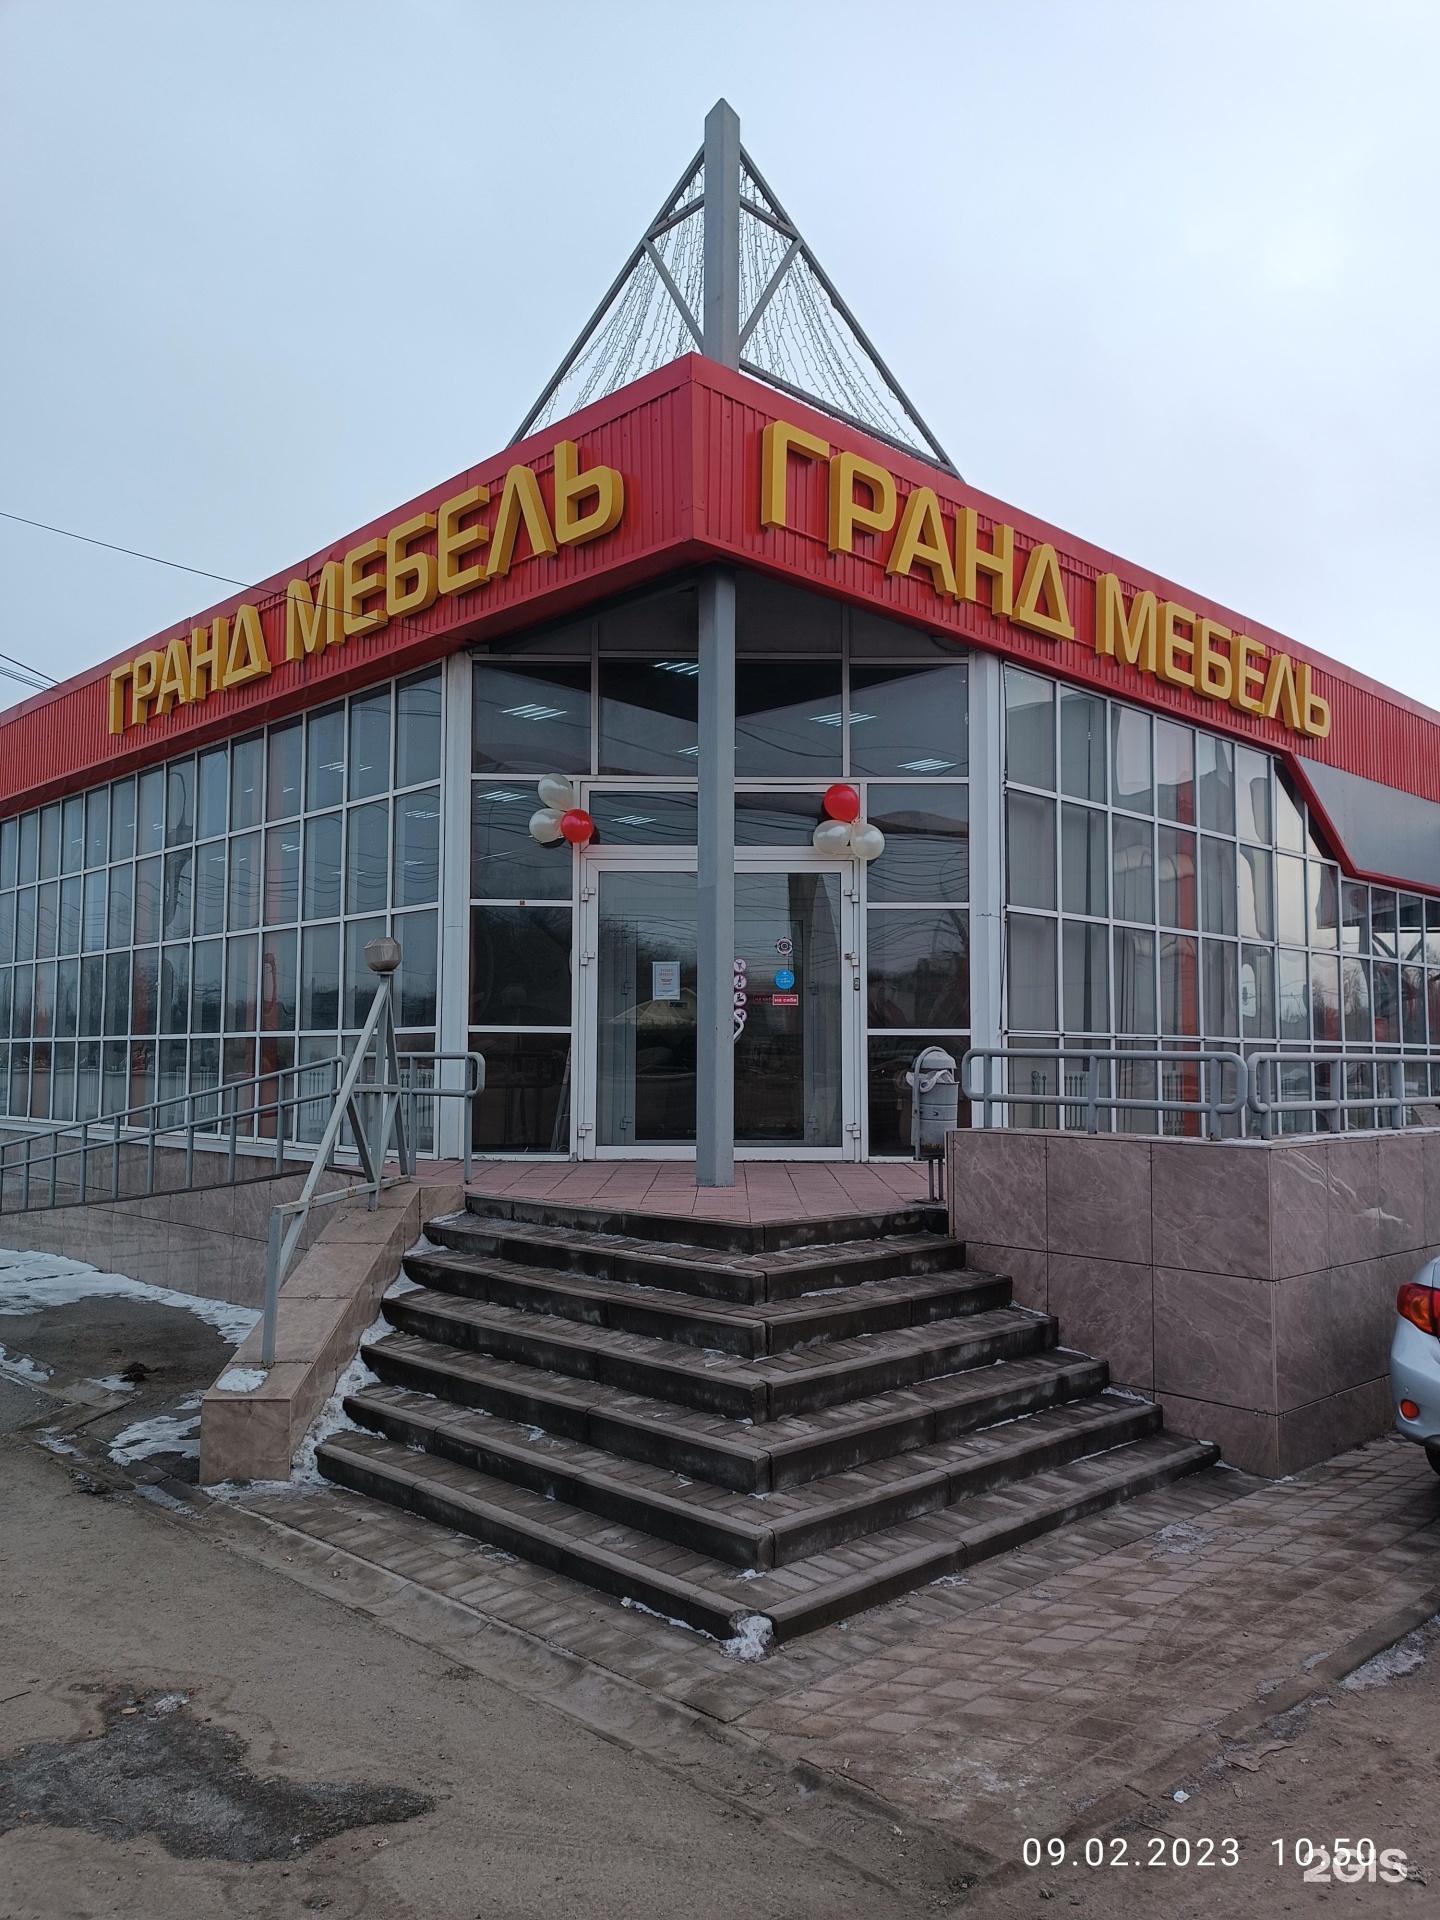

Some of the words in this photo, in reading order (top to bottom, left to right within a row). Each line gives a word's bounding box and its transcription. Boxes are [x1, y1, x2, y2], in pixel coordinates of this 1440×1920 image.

[108, 604, 272, 735] ГРАНД
[285, 440, 625, 663] МЕБЕЛЬ
[761, 419, 1075, 641] ГРАНД
[1095, 573, 1331, 739] МЕБЕЛЬ
